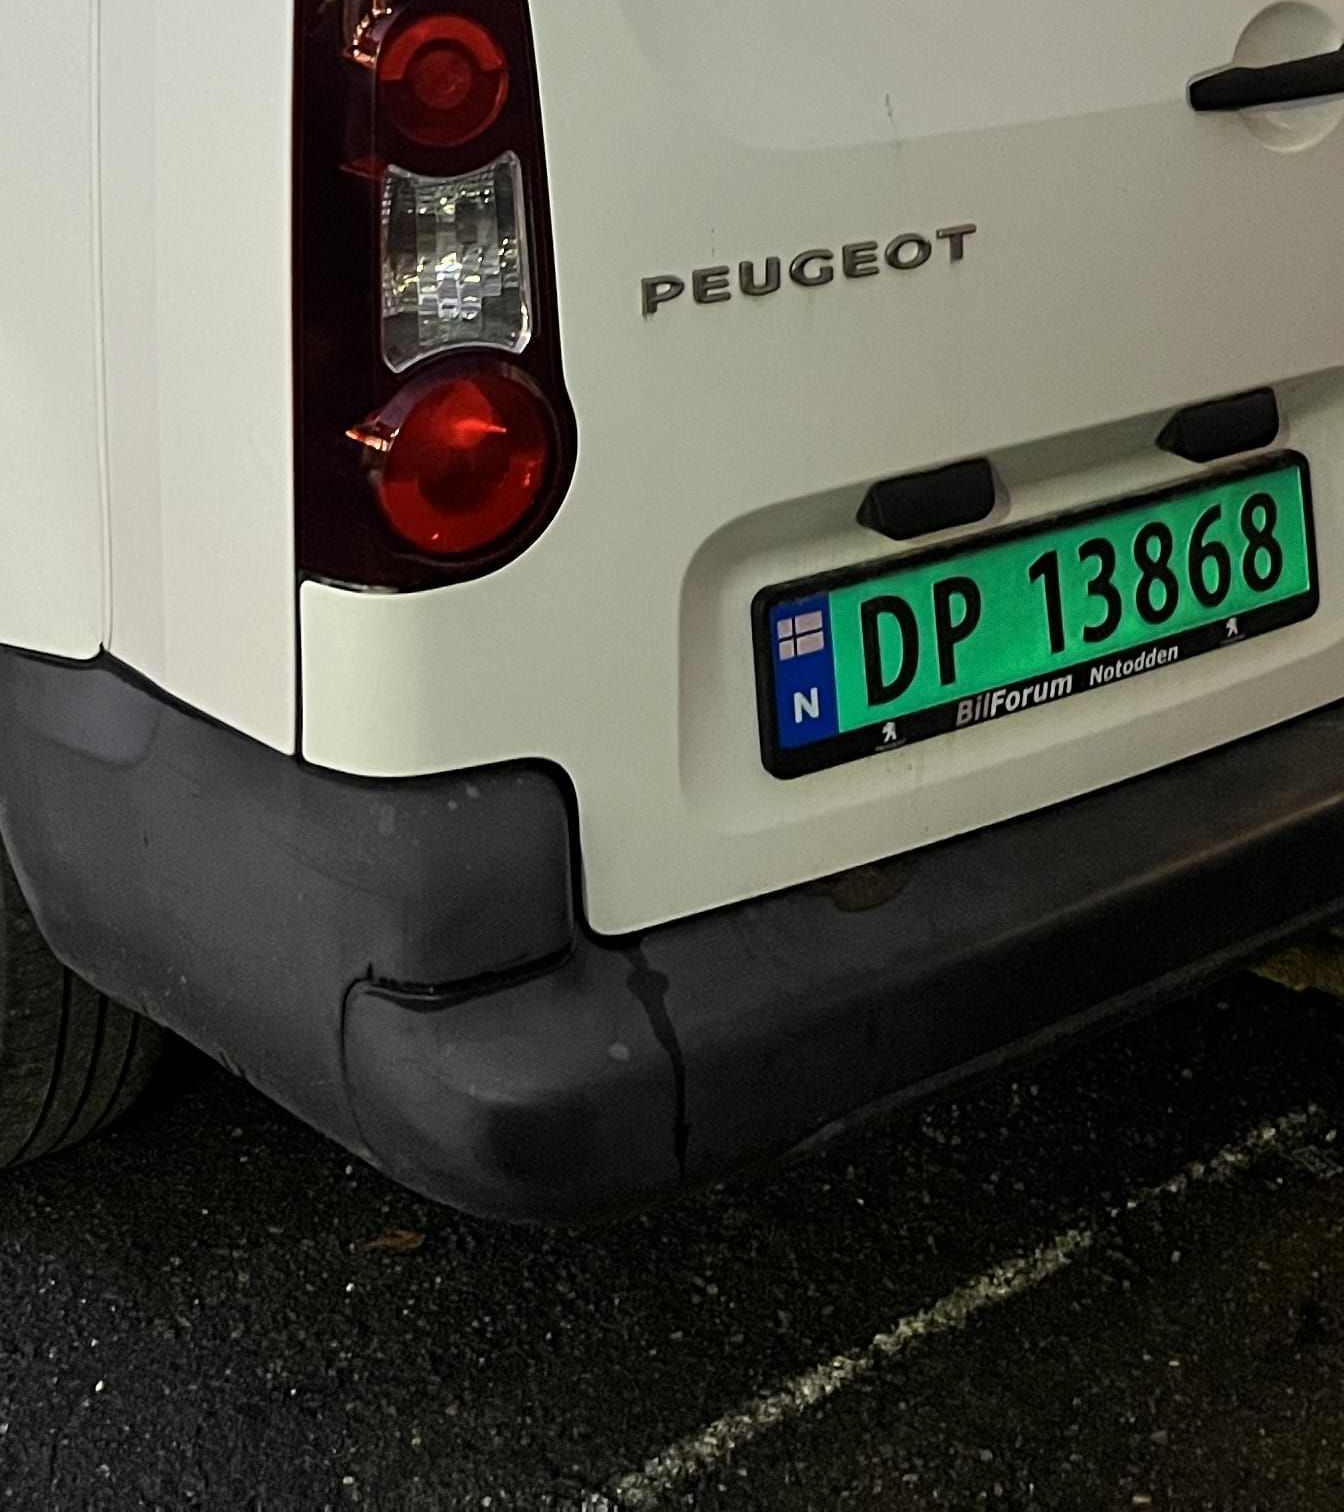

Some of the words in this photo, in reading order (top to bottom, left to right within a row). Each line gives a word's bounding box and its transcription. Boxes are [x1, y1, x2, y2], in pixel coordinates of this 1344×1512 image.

[640, 223, 978, 316] PEUGEOT
[859, 575, 983, 706] DP
[1028, 492, 1284, 655] 13868
[792, 687, 820, 724] N
[955, 674, 1073, 726] BilForum
[1089, 644, 1179, 687] Notodden
